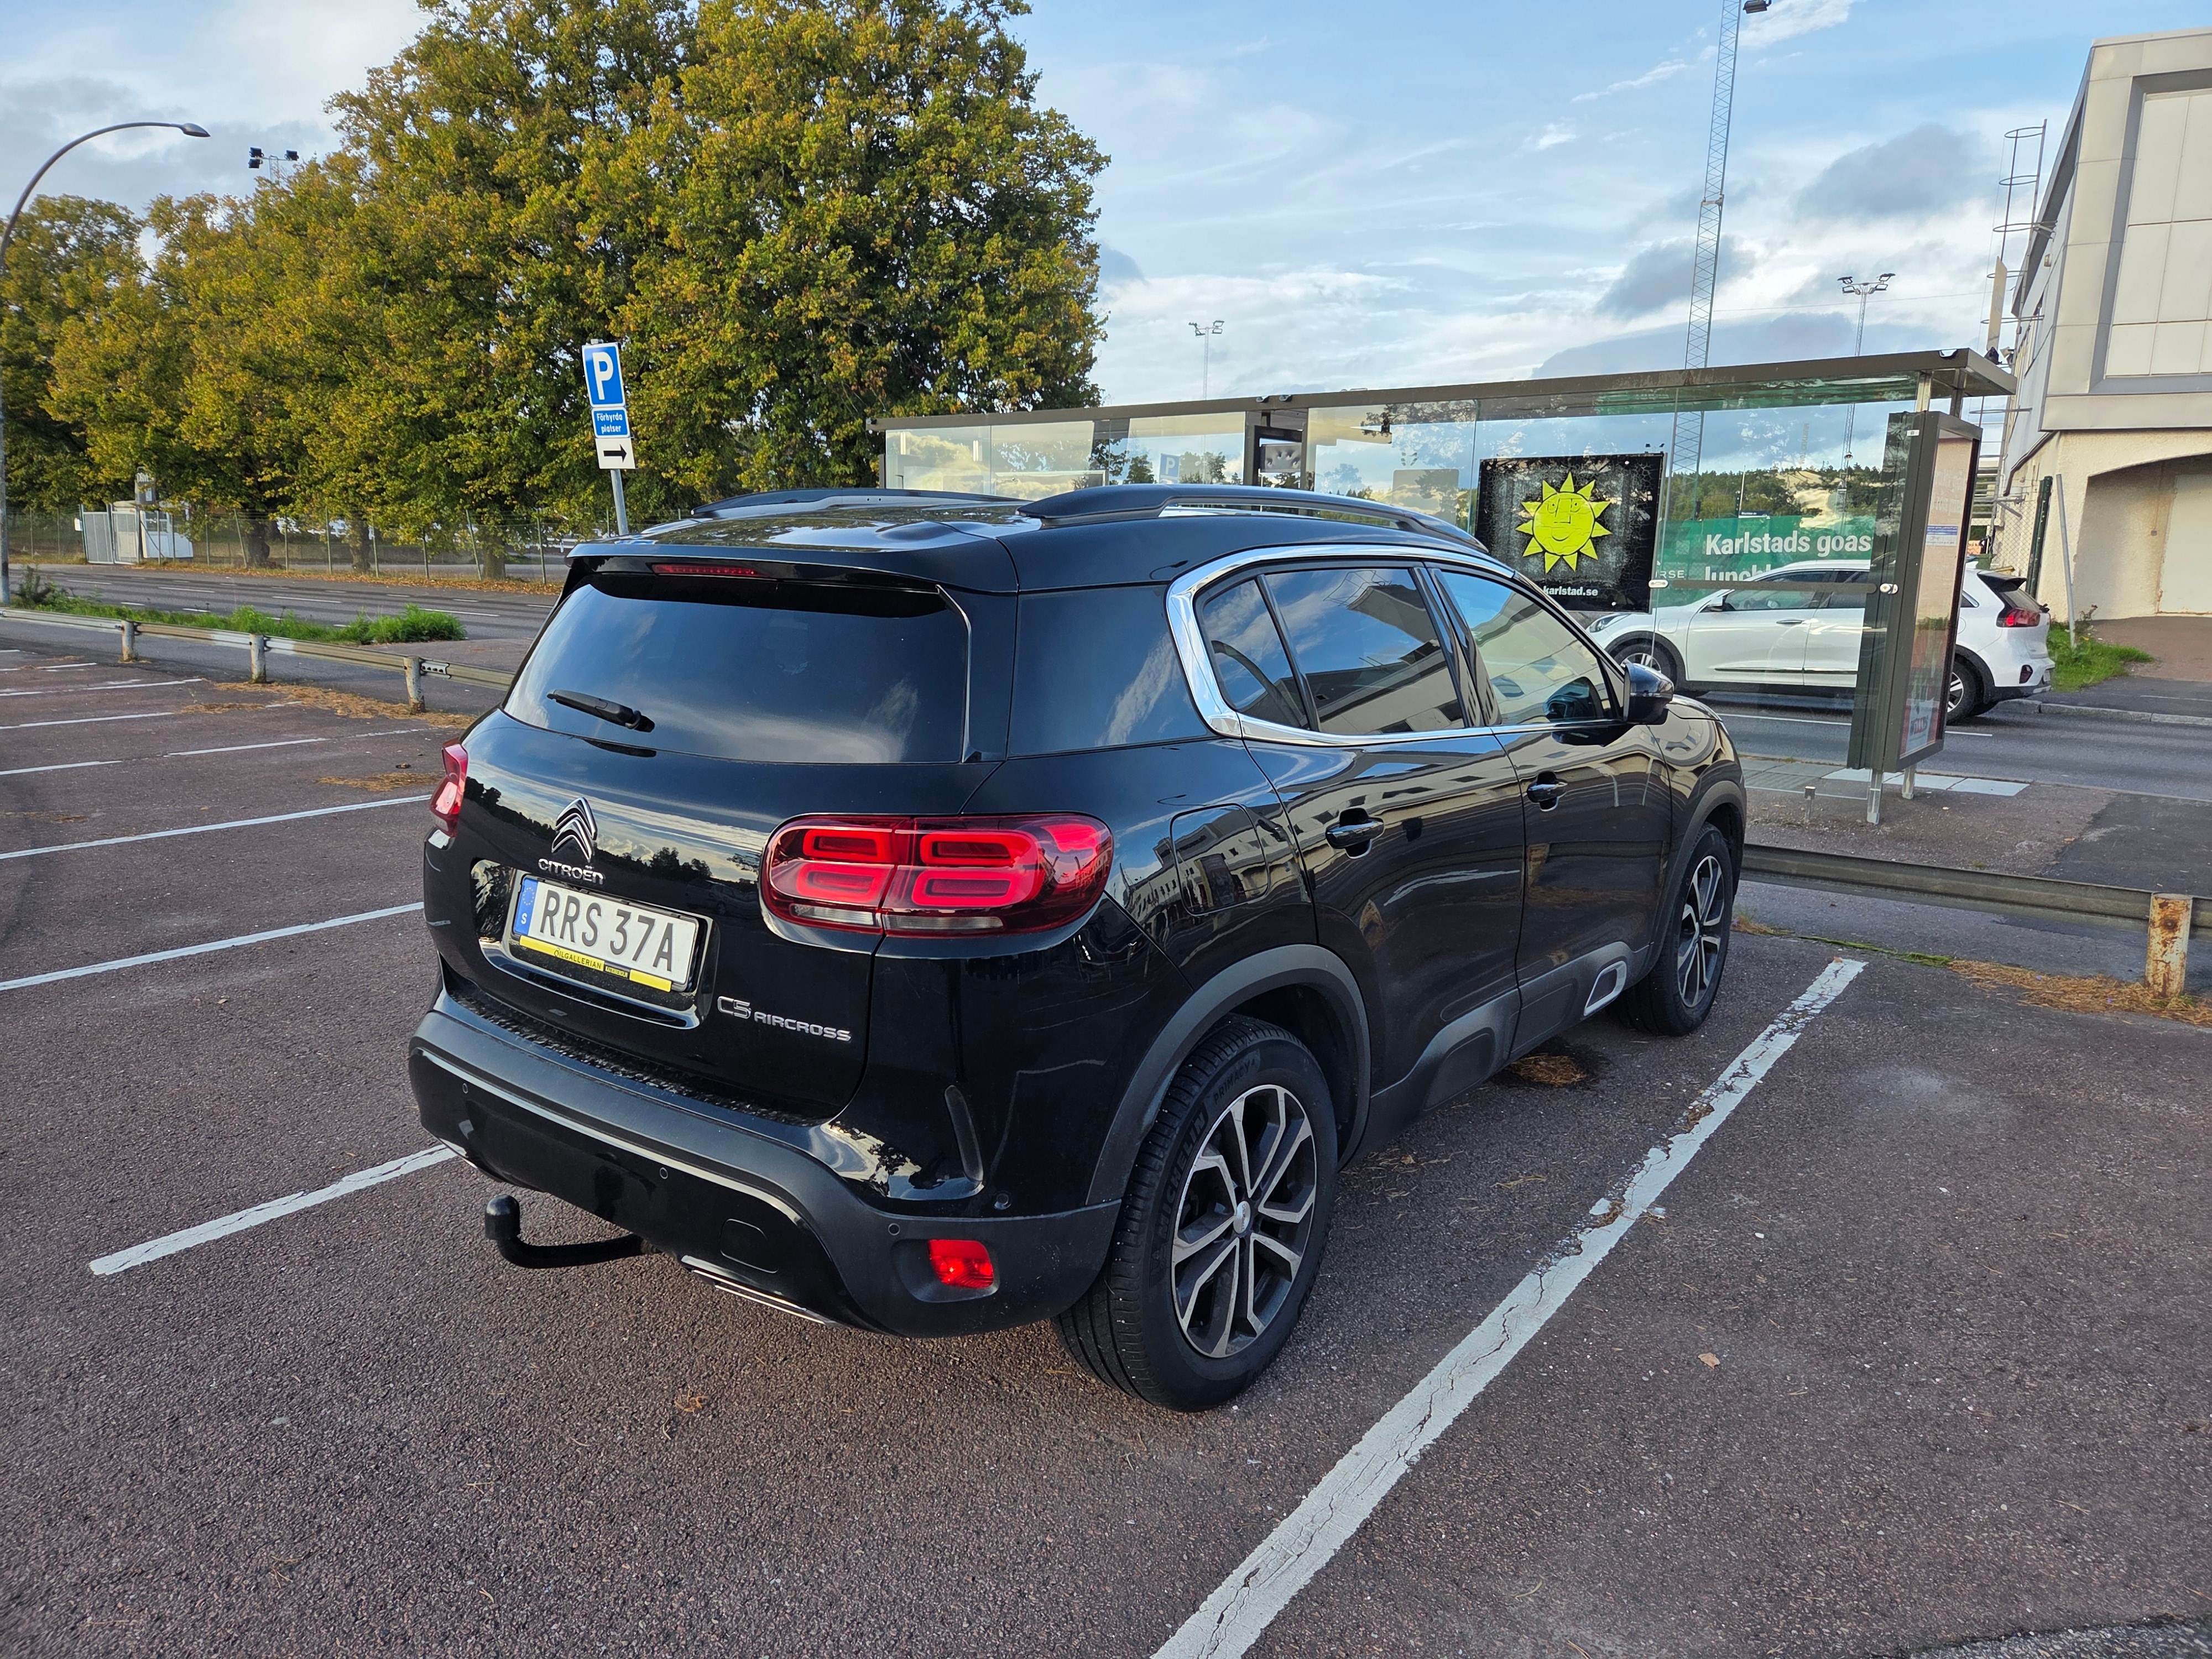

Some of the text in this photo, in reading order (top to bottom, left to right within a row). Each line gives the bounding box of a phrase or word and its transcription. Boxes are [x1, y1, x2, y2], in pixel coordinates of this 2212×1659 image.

[592, 352, 614, 400] P
[596, 412, 623, 422] Förhyrda
[601, 424, 622, 434] platser
[1165, 457, 1176, 475] P
[1705, 530, 1874, 557] Karlstads goas
[1655, 570, 1685, 578] RSE
[1705, 564, 1771, 581] lunch
[1543, 586, 1598, 596] karlstad.se
[521, 913, 528, 925] S
[540, 889, 674, 972] RRS 37A
[717, 996, 851, 1042] C5 AIRCROSS
[1213, 1060, 1250, 1105] PRIMACY
[1158, 1112, 1206, 1240] MICHELIN
